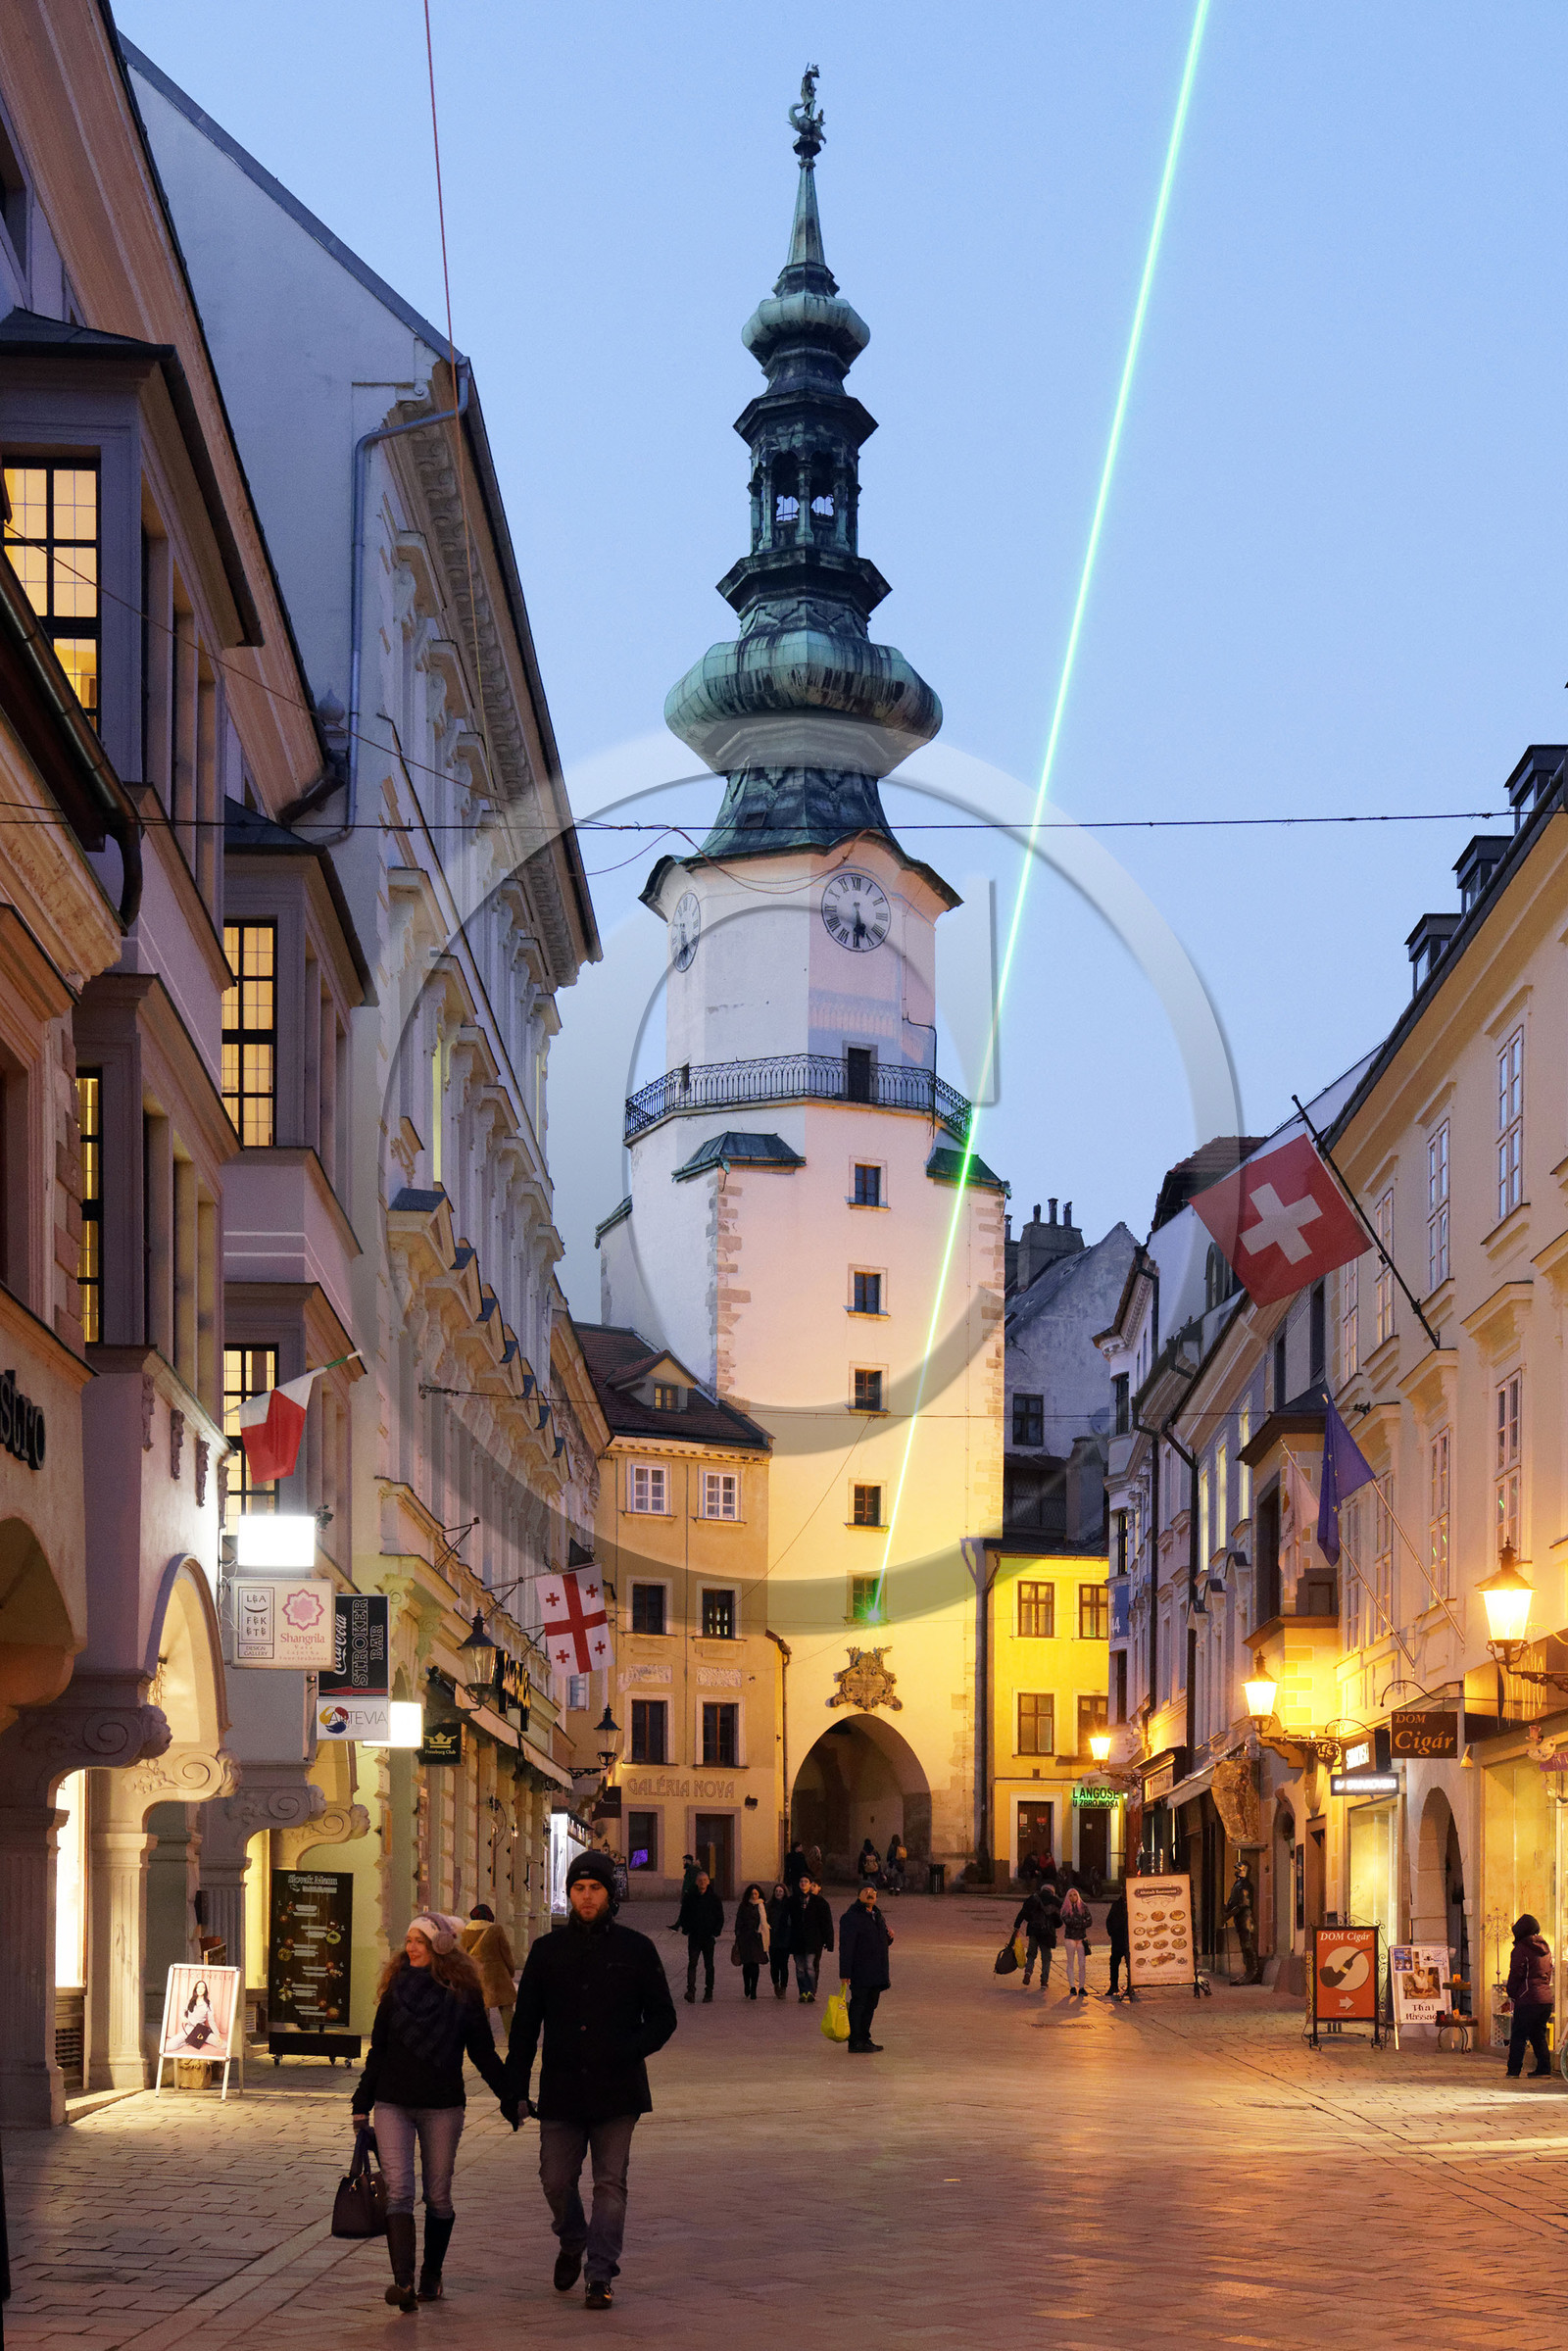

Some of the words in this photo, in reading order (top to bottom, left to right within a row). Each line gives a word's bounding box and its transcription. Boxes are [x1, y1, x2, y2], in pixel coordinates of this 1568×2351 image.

[280, 1632, 325, 1645] Shangrila
[352, 1598, 368, 1687] STROKER
[370, 1624, 384, 1660] BAR
[1395, 1714, 1426, 1724] DOM
[1395, 1731, 1454, 1755] Cigár
[627, 1775, 690, 1797] GALÉRIA
[693, 1780, 735, 1799] NOVA
[1320, 1933, 1345, 1941] DOM
[1347, 1932, 1370, 1942] Cigár
